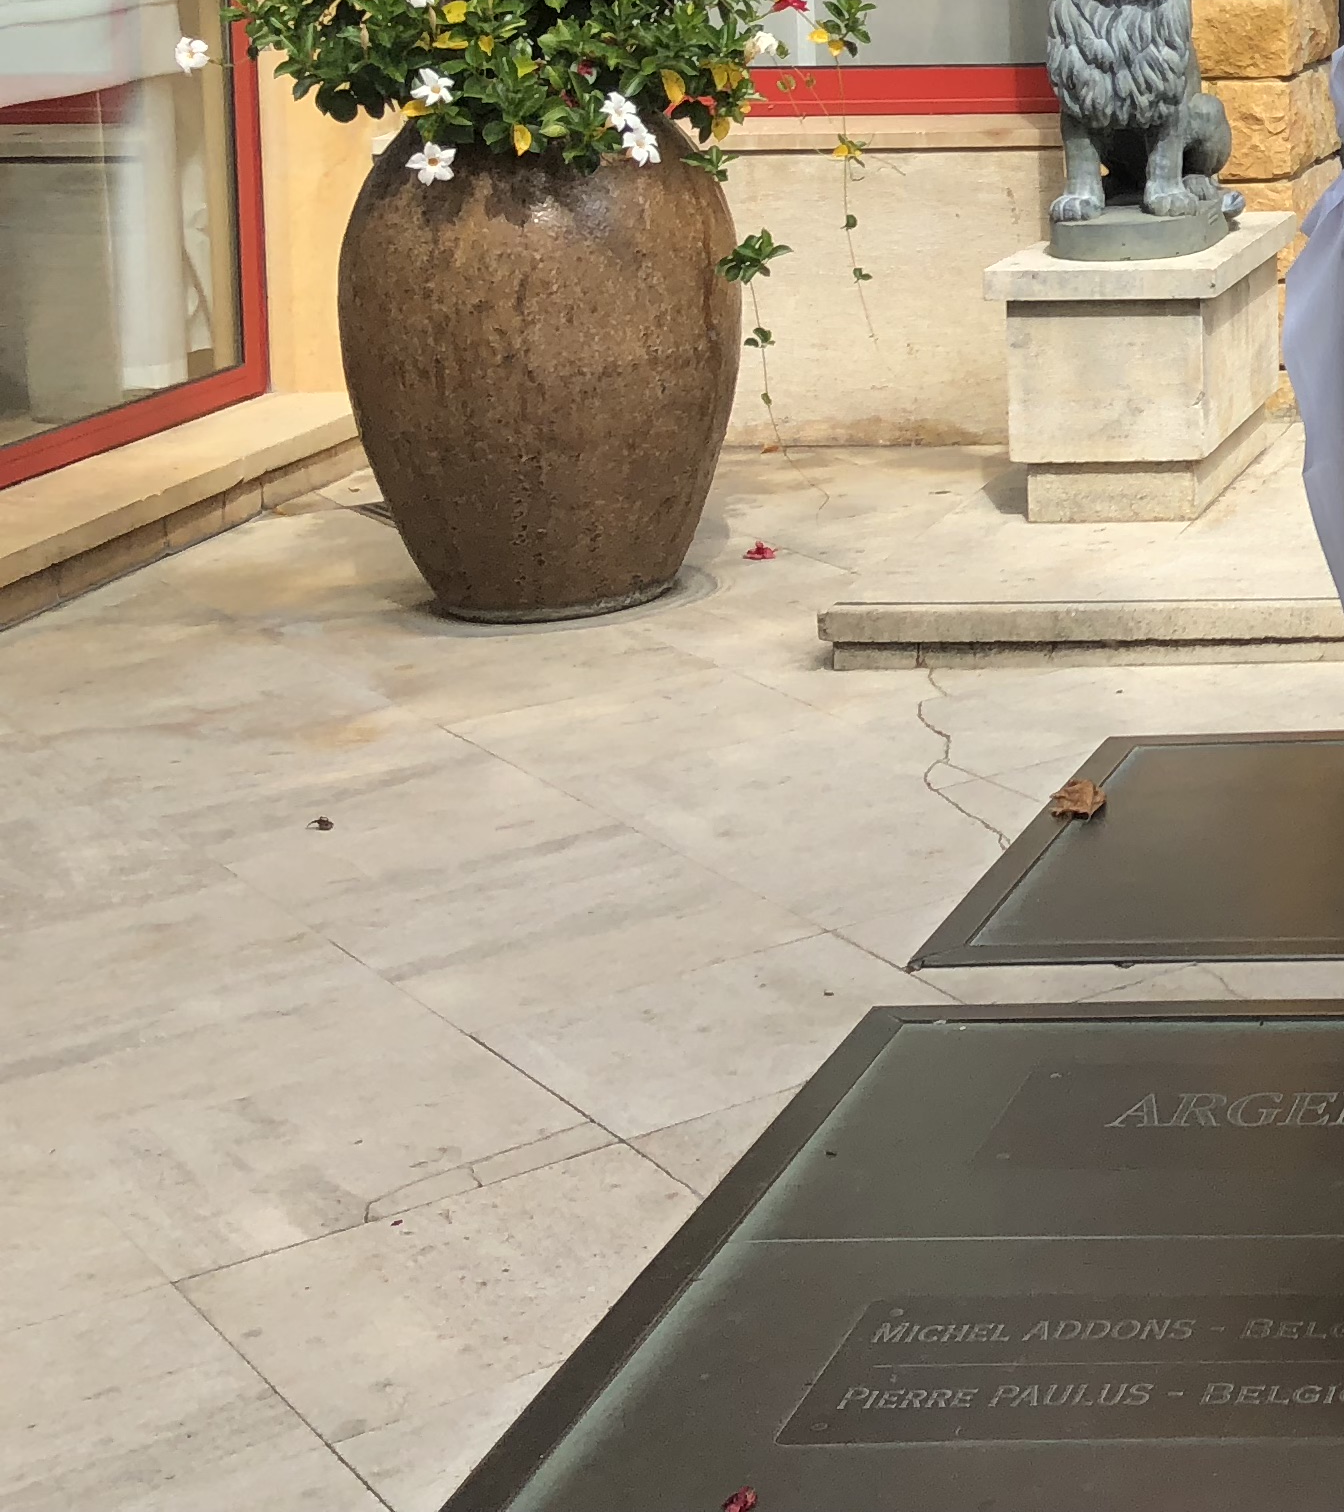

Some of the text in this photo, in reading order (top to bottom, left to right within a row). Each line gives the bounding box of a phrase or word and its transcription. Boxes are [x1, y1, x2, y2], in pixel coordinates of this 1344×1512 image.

[870, 1321, 1010, 1343] MICHEL
[1021, 1319, 1197, 1341] ADDONS
[836, 1387, 979, 1410] PIERRE
[988, 1383, 1154, 1408] PAULUS
